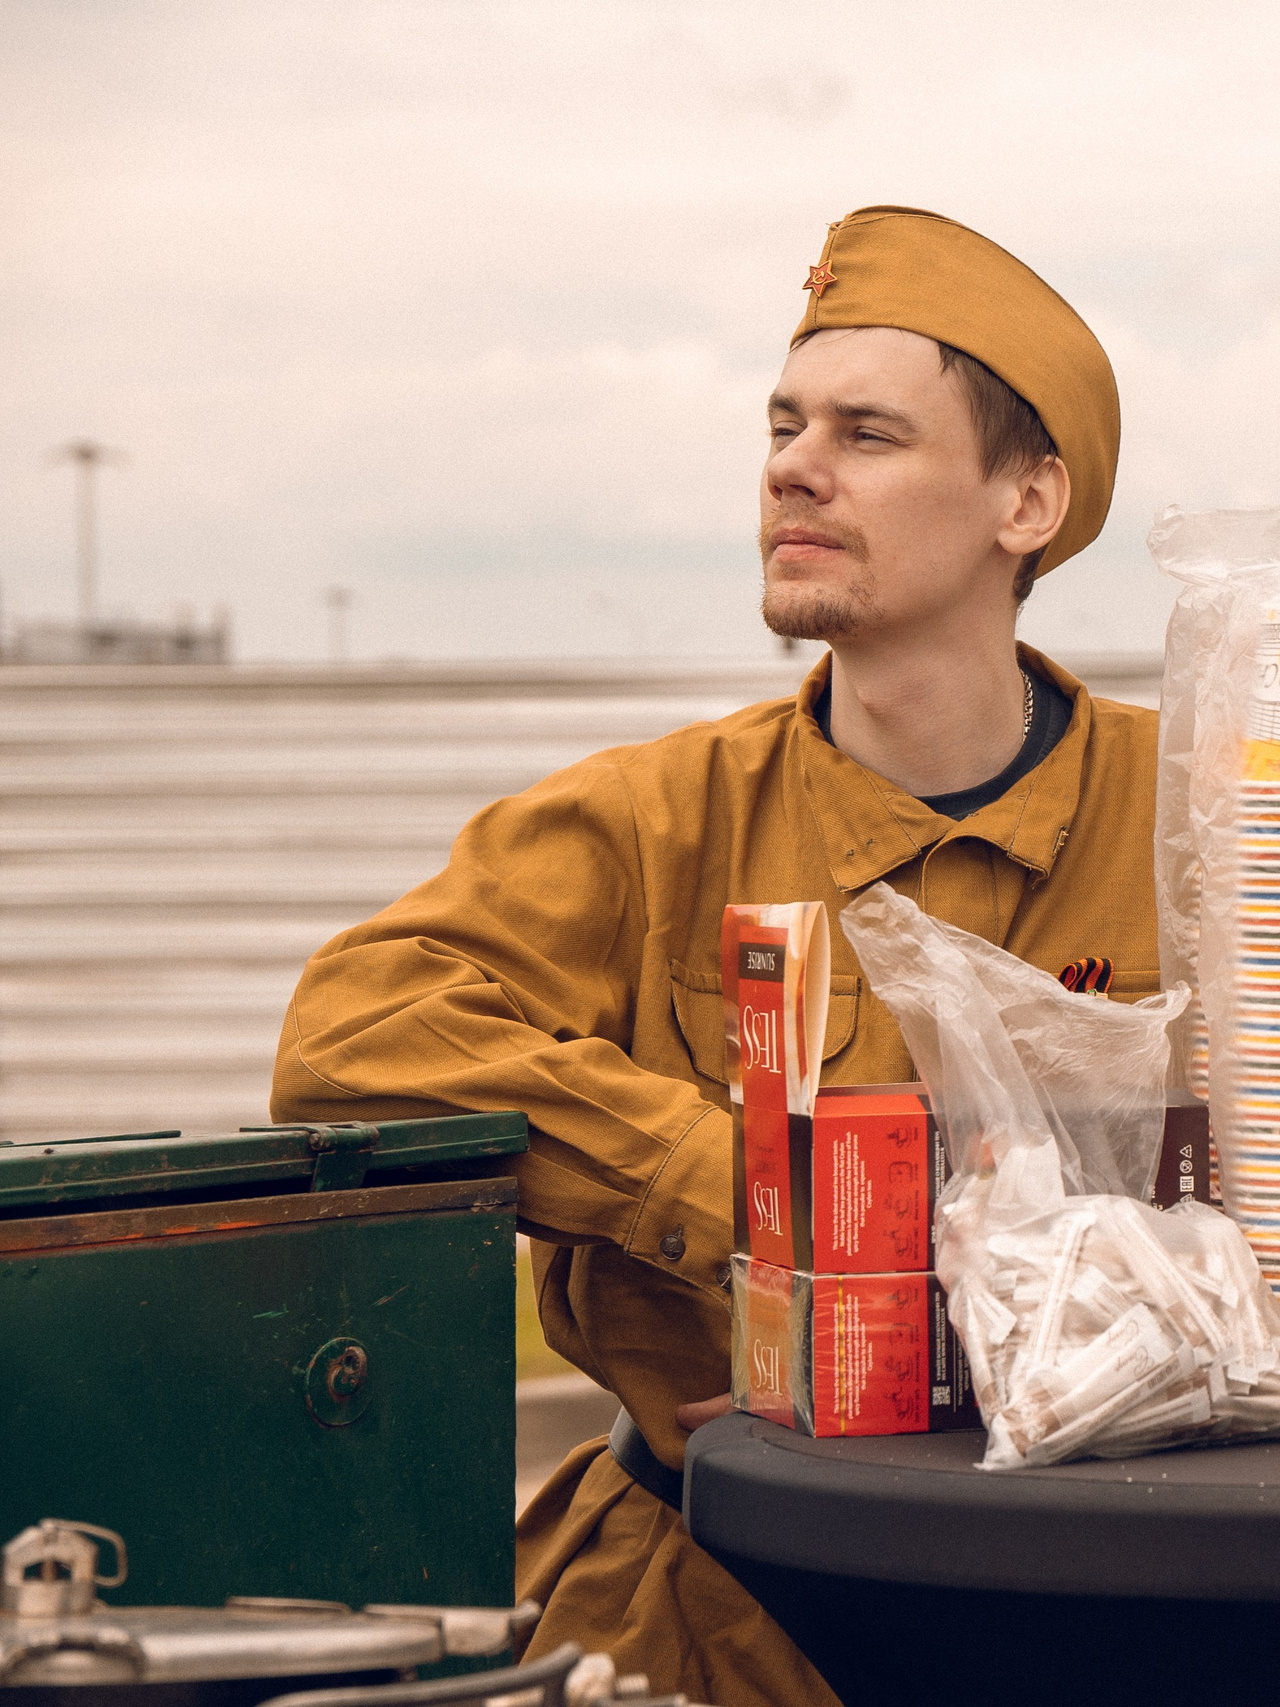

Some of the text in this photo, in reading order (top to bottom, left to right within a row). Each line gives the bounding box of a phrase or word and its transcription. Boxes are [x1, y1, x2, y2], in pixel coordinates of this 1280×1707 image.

[747, 951, 776, 971] SUNRISE
[743, 1004, 782, 1074] TESS
[754, 1181, 783, 1236] TESS
[754, 1339, 783, 1396] TESS
